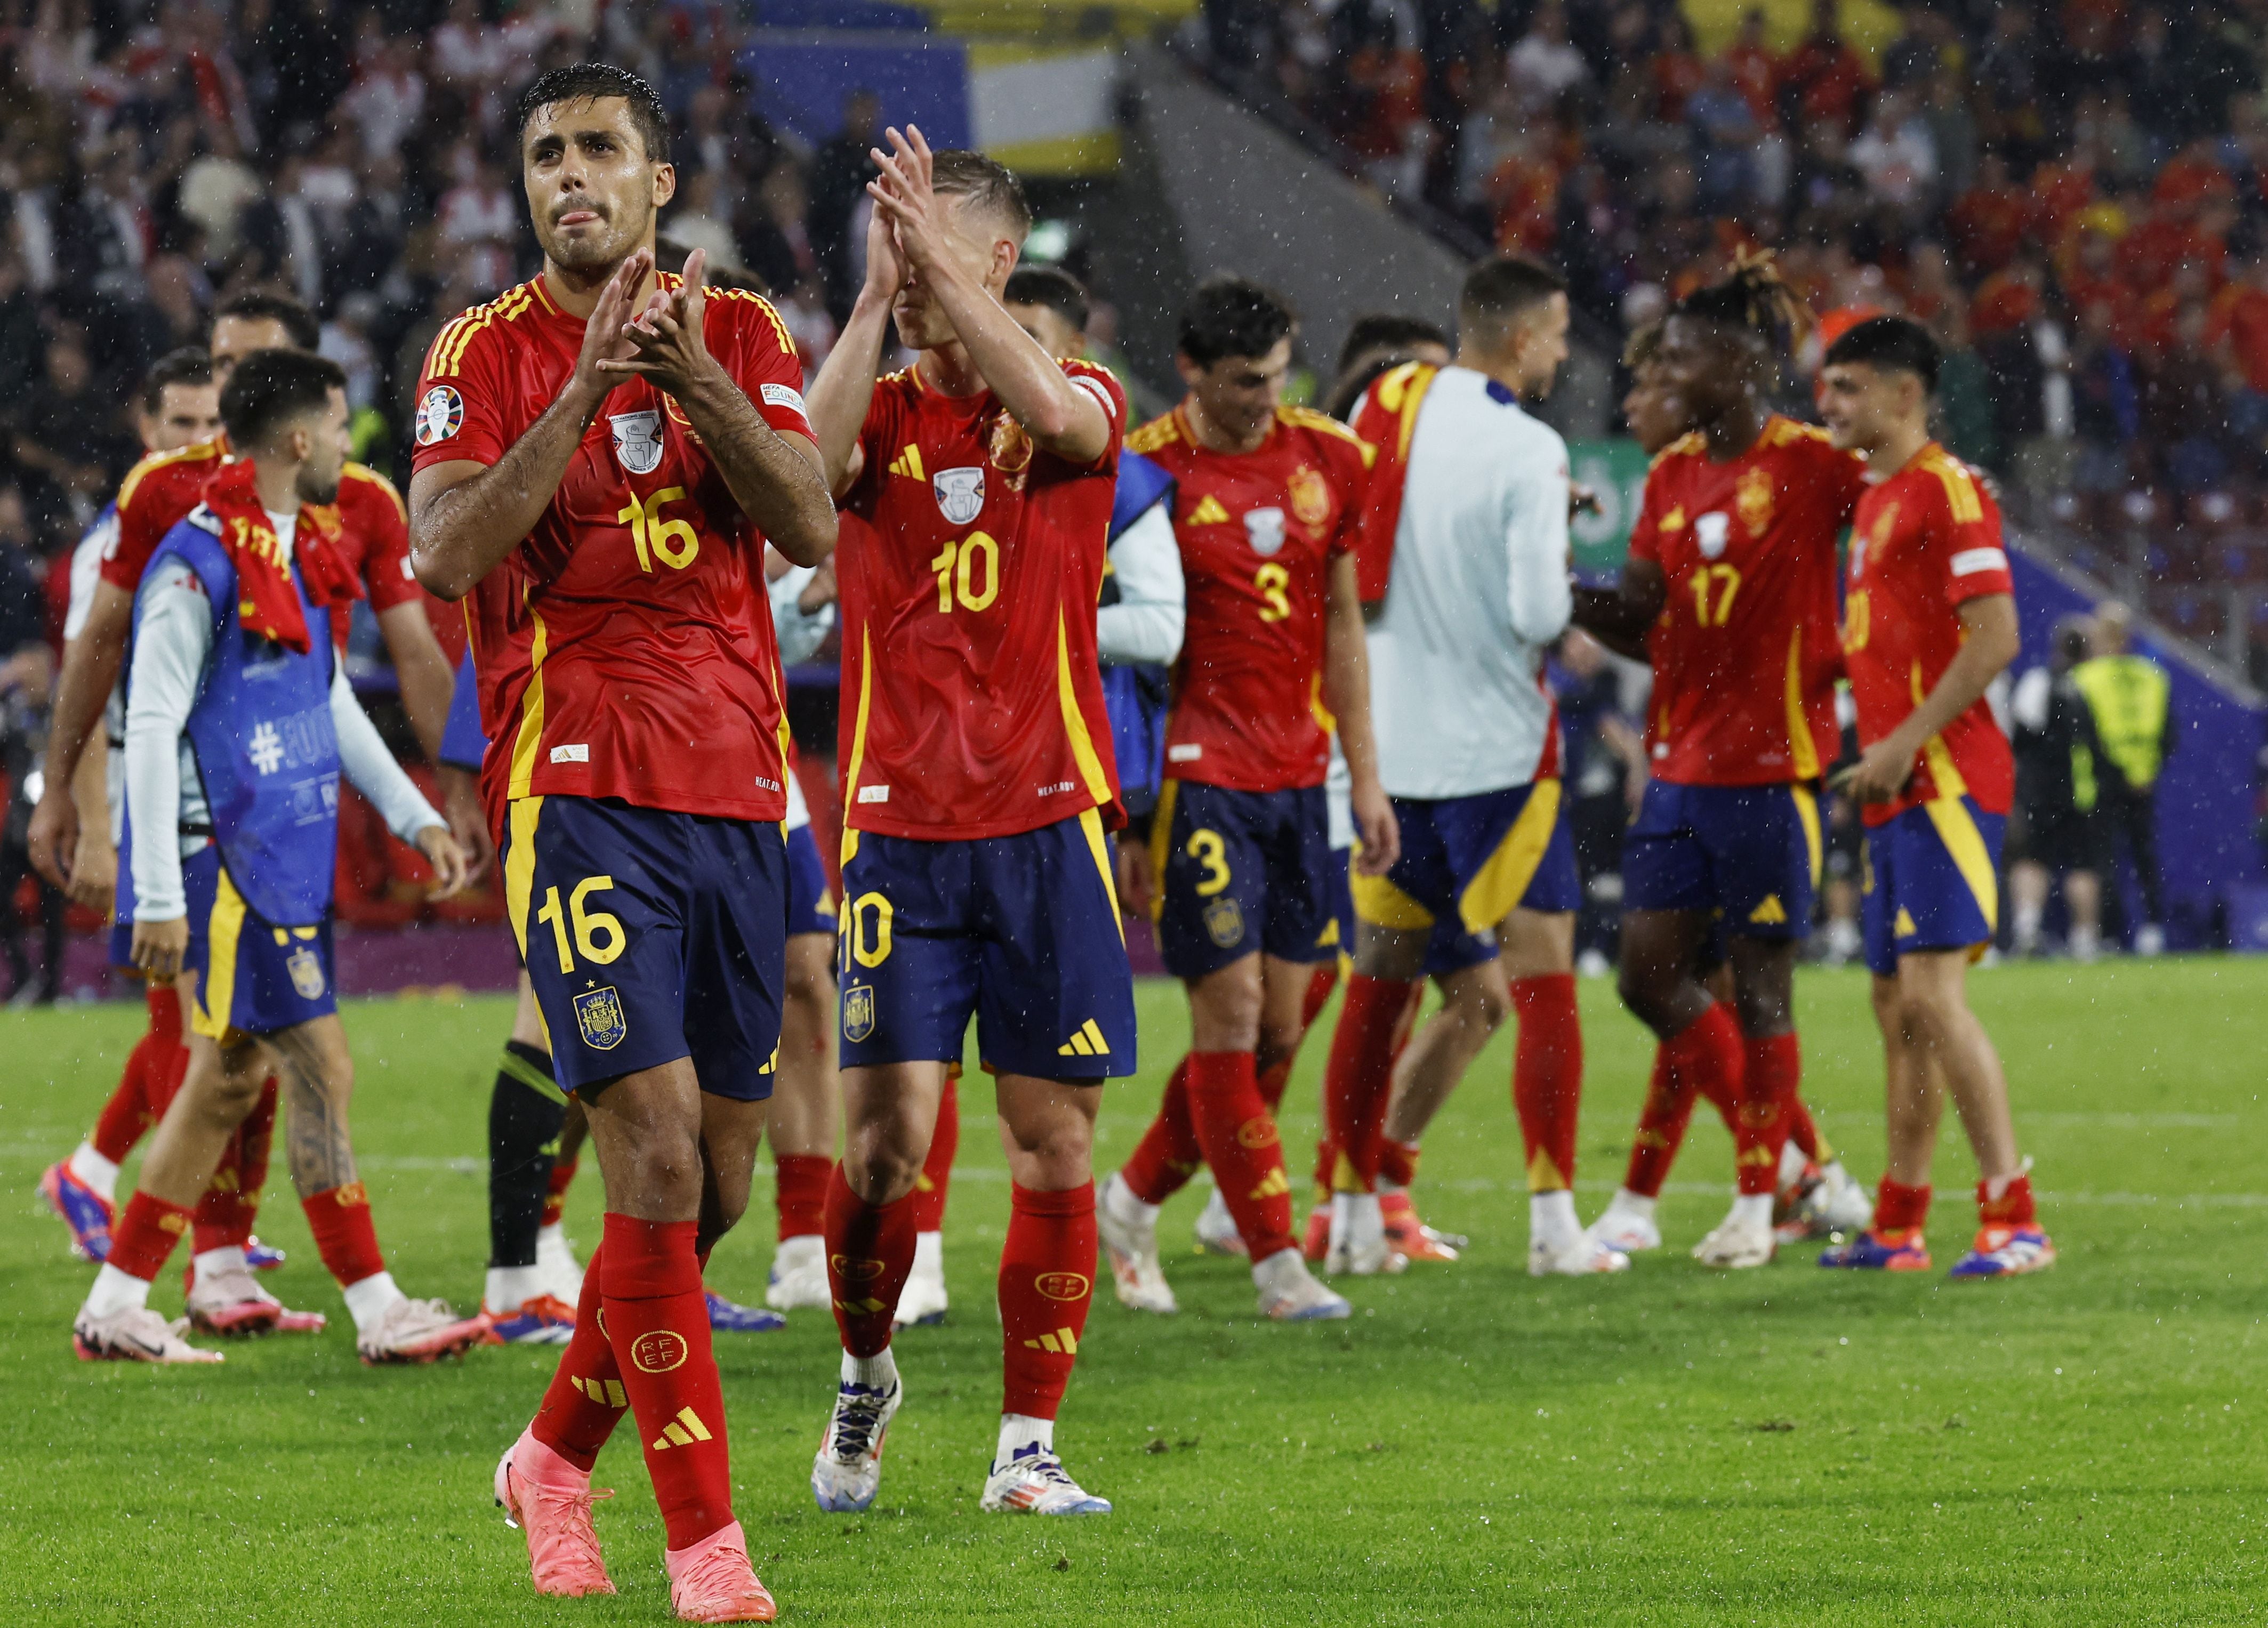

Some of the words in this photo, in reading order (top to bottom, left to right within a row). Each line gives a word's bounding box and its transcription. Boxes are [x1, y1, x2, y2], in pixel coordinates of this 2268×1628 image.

[618, 486, 699, 573] 16
[932, 531, 999, 613] 10
[1254, 562, 1290, 622] 3
[1688, 563, 1741, 627] 17
[1186, 828, 1232, 896] 3
[537, 875, 626, 974] 16
